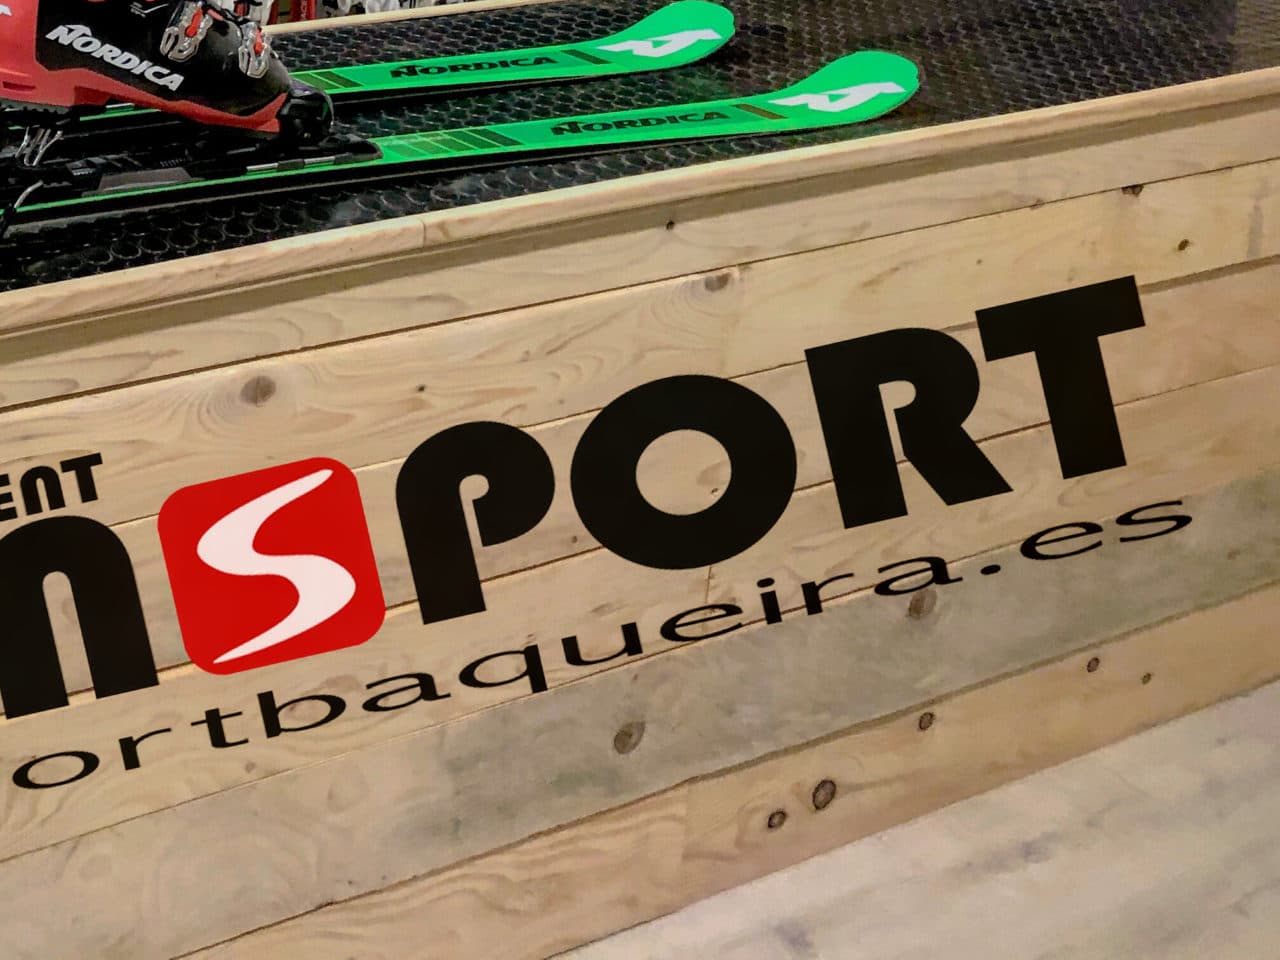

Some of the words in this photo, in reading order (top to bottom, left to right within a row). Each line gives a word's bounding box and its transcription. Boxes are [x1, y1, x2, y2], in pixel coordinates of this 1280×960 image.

[45, 24, 185, 92] NORDICA
[390, 55, 558, 79] NORDICA
[551, 111, 730, 136] NORDICA
